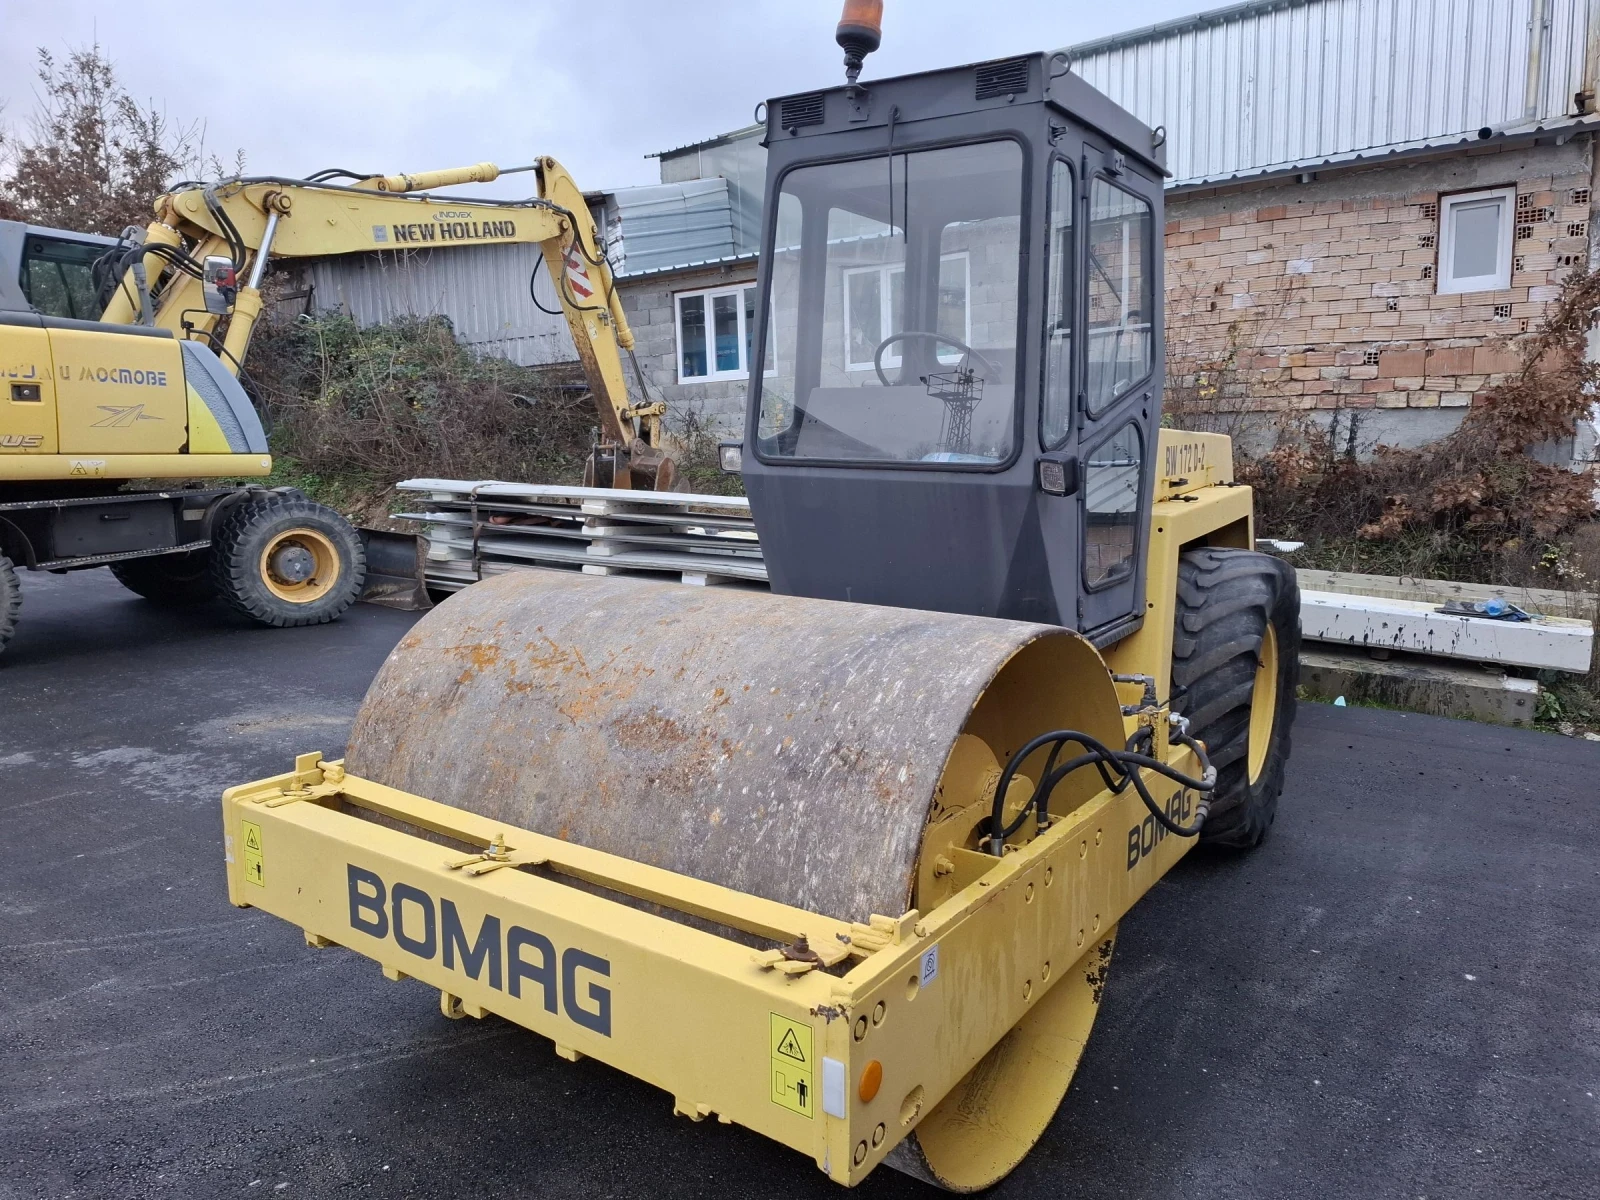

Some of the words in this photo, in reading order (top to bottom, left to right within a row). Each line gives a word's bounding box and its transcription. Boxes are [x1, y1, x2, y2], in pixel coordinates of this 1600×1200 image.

[392, 223, 436, 244] NEW
[439, 220, 517, 242] HOLLAND
[0, 434, 44, 448] US
[1165, 445, 1178, 477] BW
[1179, 443, 1192, 475] 172
[1193, 442, 1206, 472] D-2
[346, 863, 612, 1039] BOMAG
